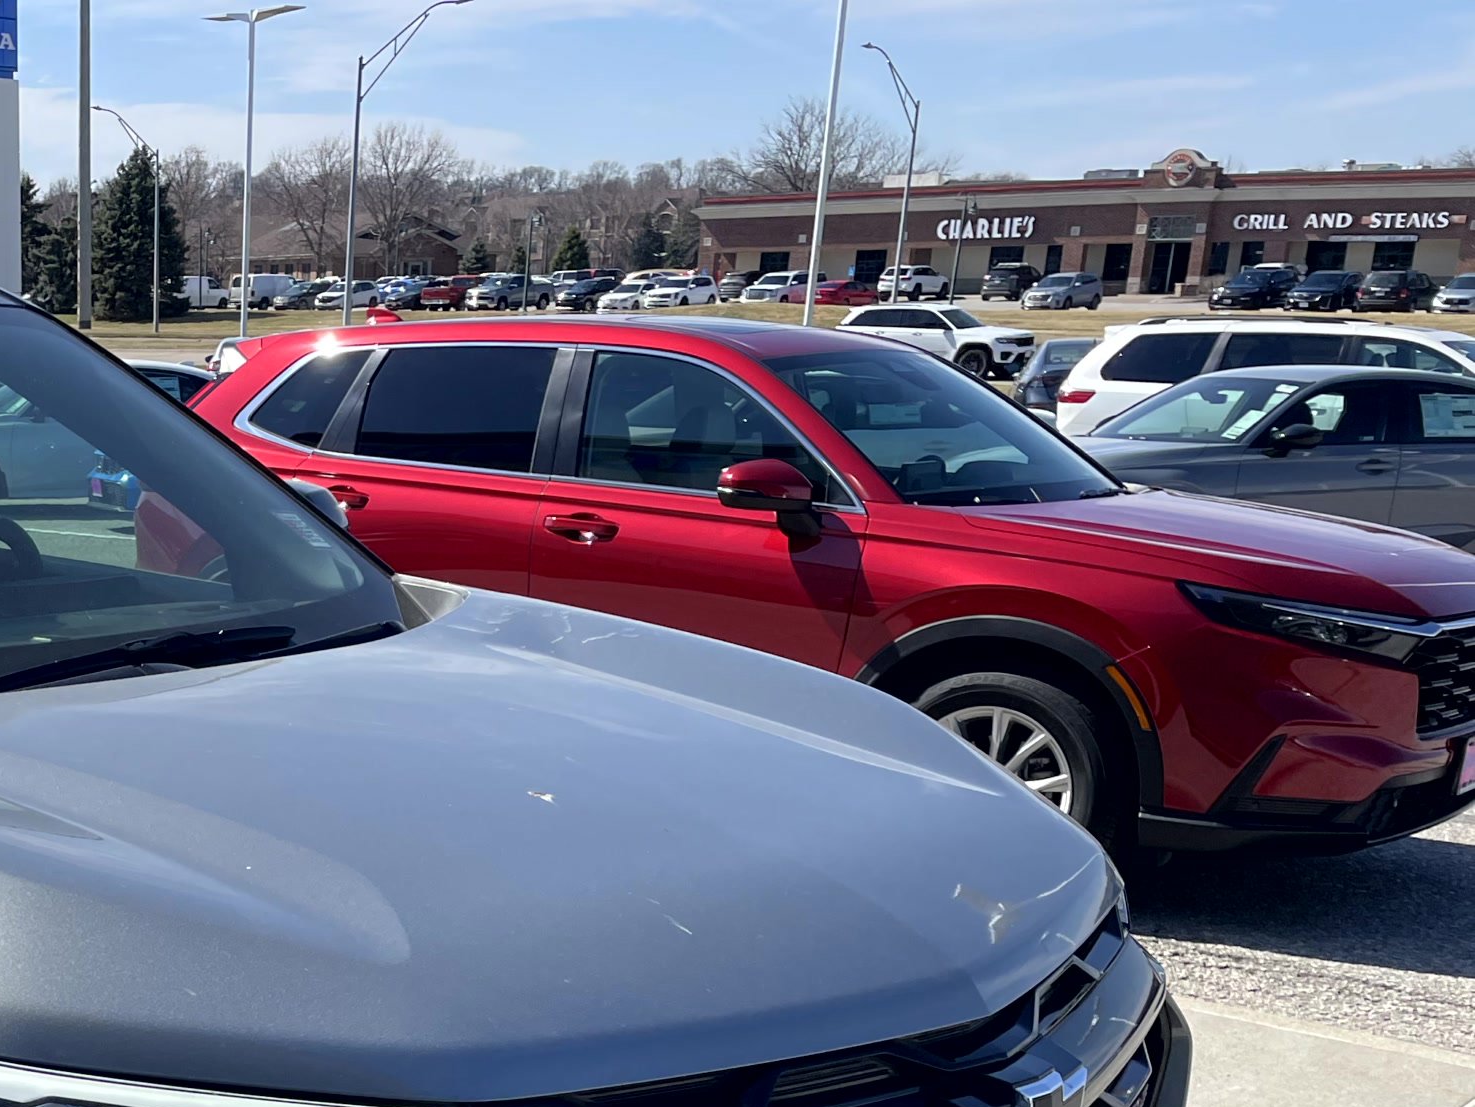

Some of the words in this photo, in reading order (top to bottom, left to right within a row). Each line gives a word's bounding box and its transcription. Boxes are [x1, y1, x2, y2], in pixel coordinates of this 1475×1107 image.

[936, 216, 1035, 240] CHARLIE'S
[1233, 213, 1288, 230] GRILL
[1304, 212, 1353, 229] AND
[1369, 211, 1450, 229] STEAKS
